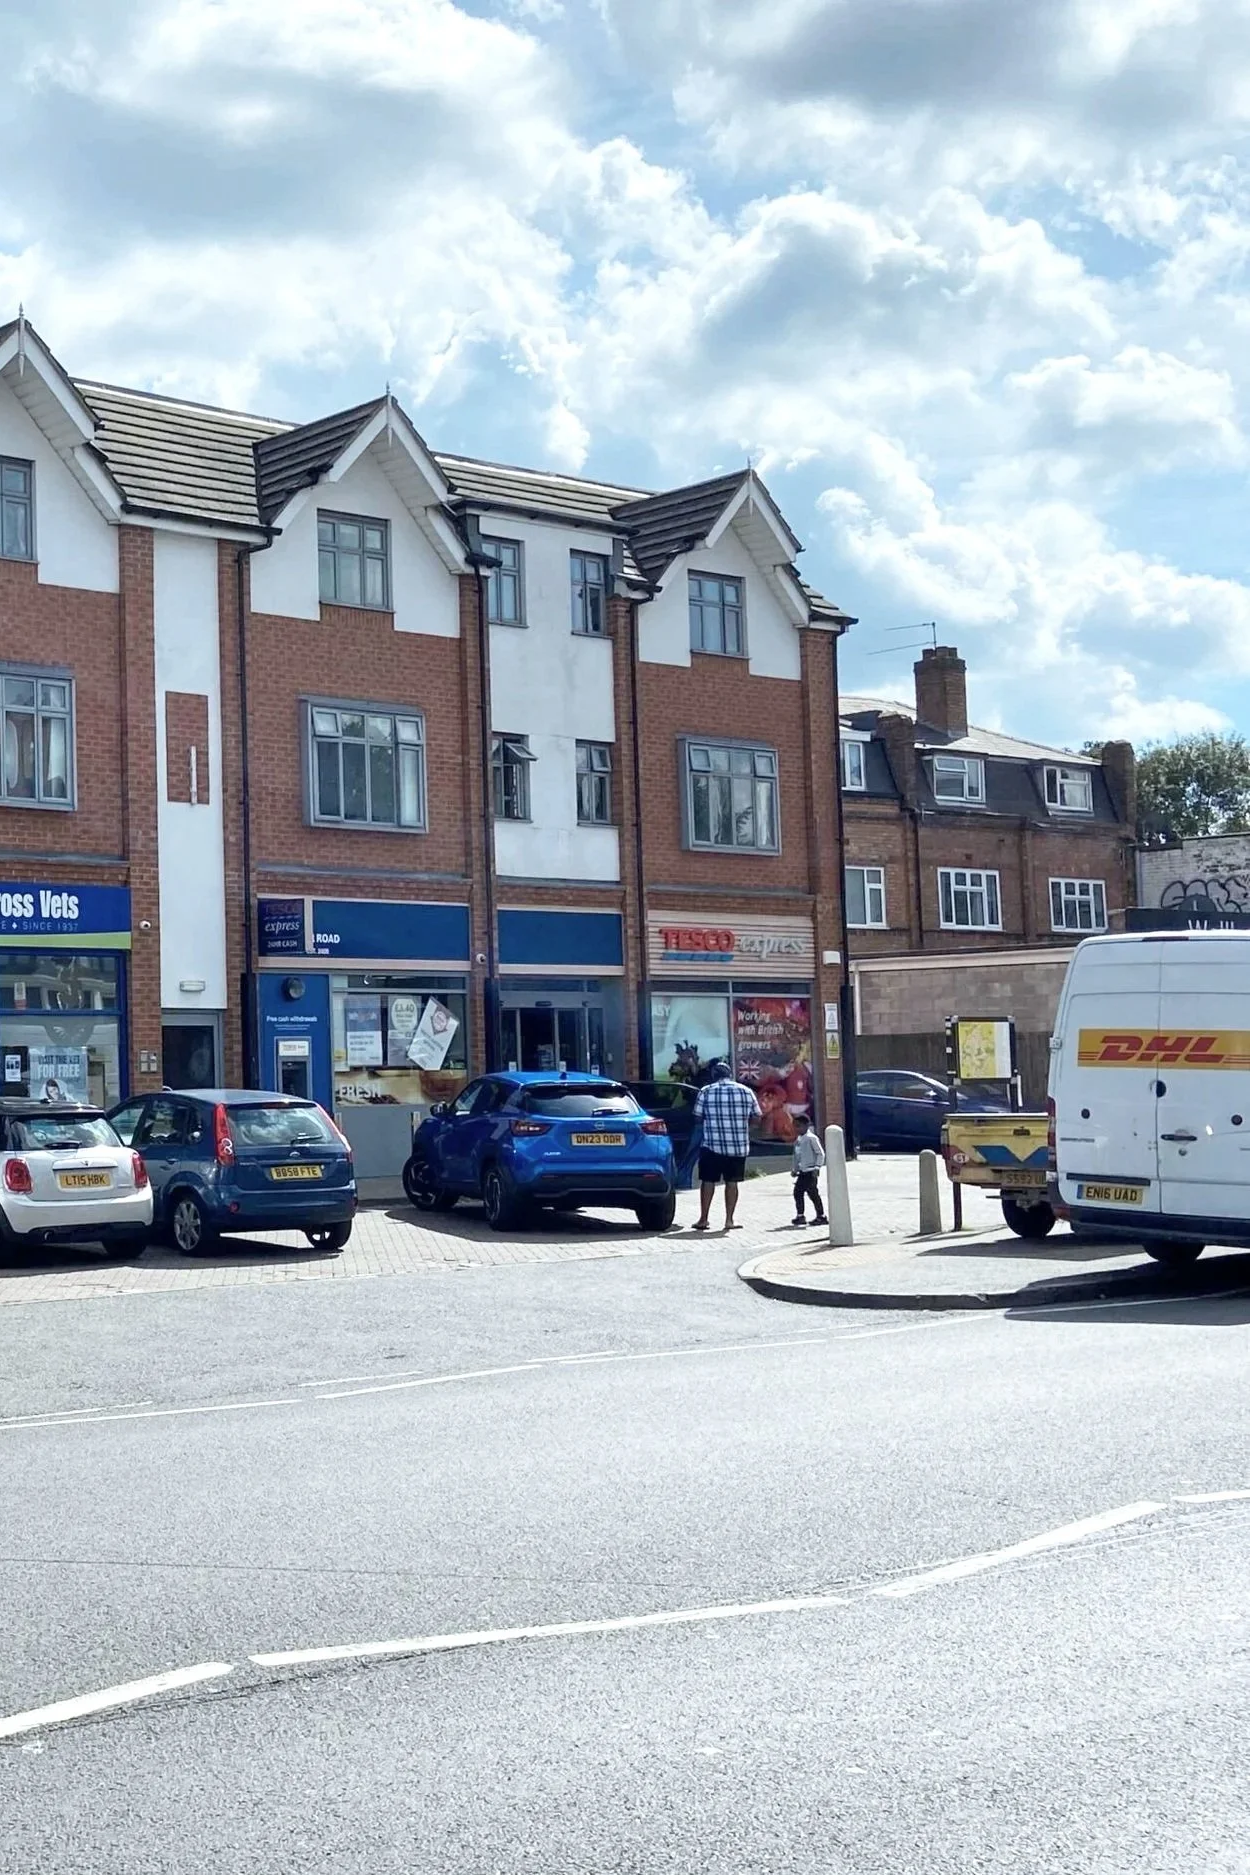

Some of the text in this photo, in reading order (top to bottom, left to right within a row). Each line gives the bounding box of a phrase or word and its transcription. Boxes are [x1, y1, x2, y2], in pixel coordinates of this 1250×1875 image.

[39, 890, 79, 919] Vets
[22, 921, 52, 931] SINCE
[57, 922, 79, 932] 1937
[264, 921, 300, 936] express
[316, 933, 340, 943] ROAD
[659, 927, 806, 960] TESCO express
[738, 1009, 771, 1022] Working
[738, 1023, 784, 1035] with British
[738, 1040, 771, 1052] growers
[1098, 1035, 1225, 1063] DHL
[58, 1064, 80, 1078] FREE
[300, 1166, 318, 1176] FTE
[66, 1175, 86, 1185] LT15
[1086, 1186, 1110, 1199] EN16
